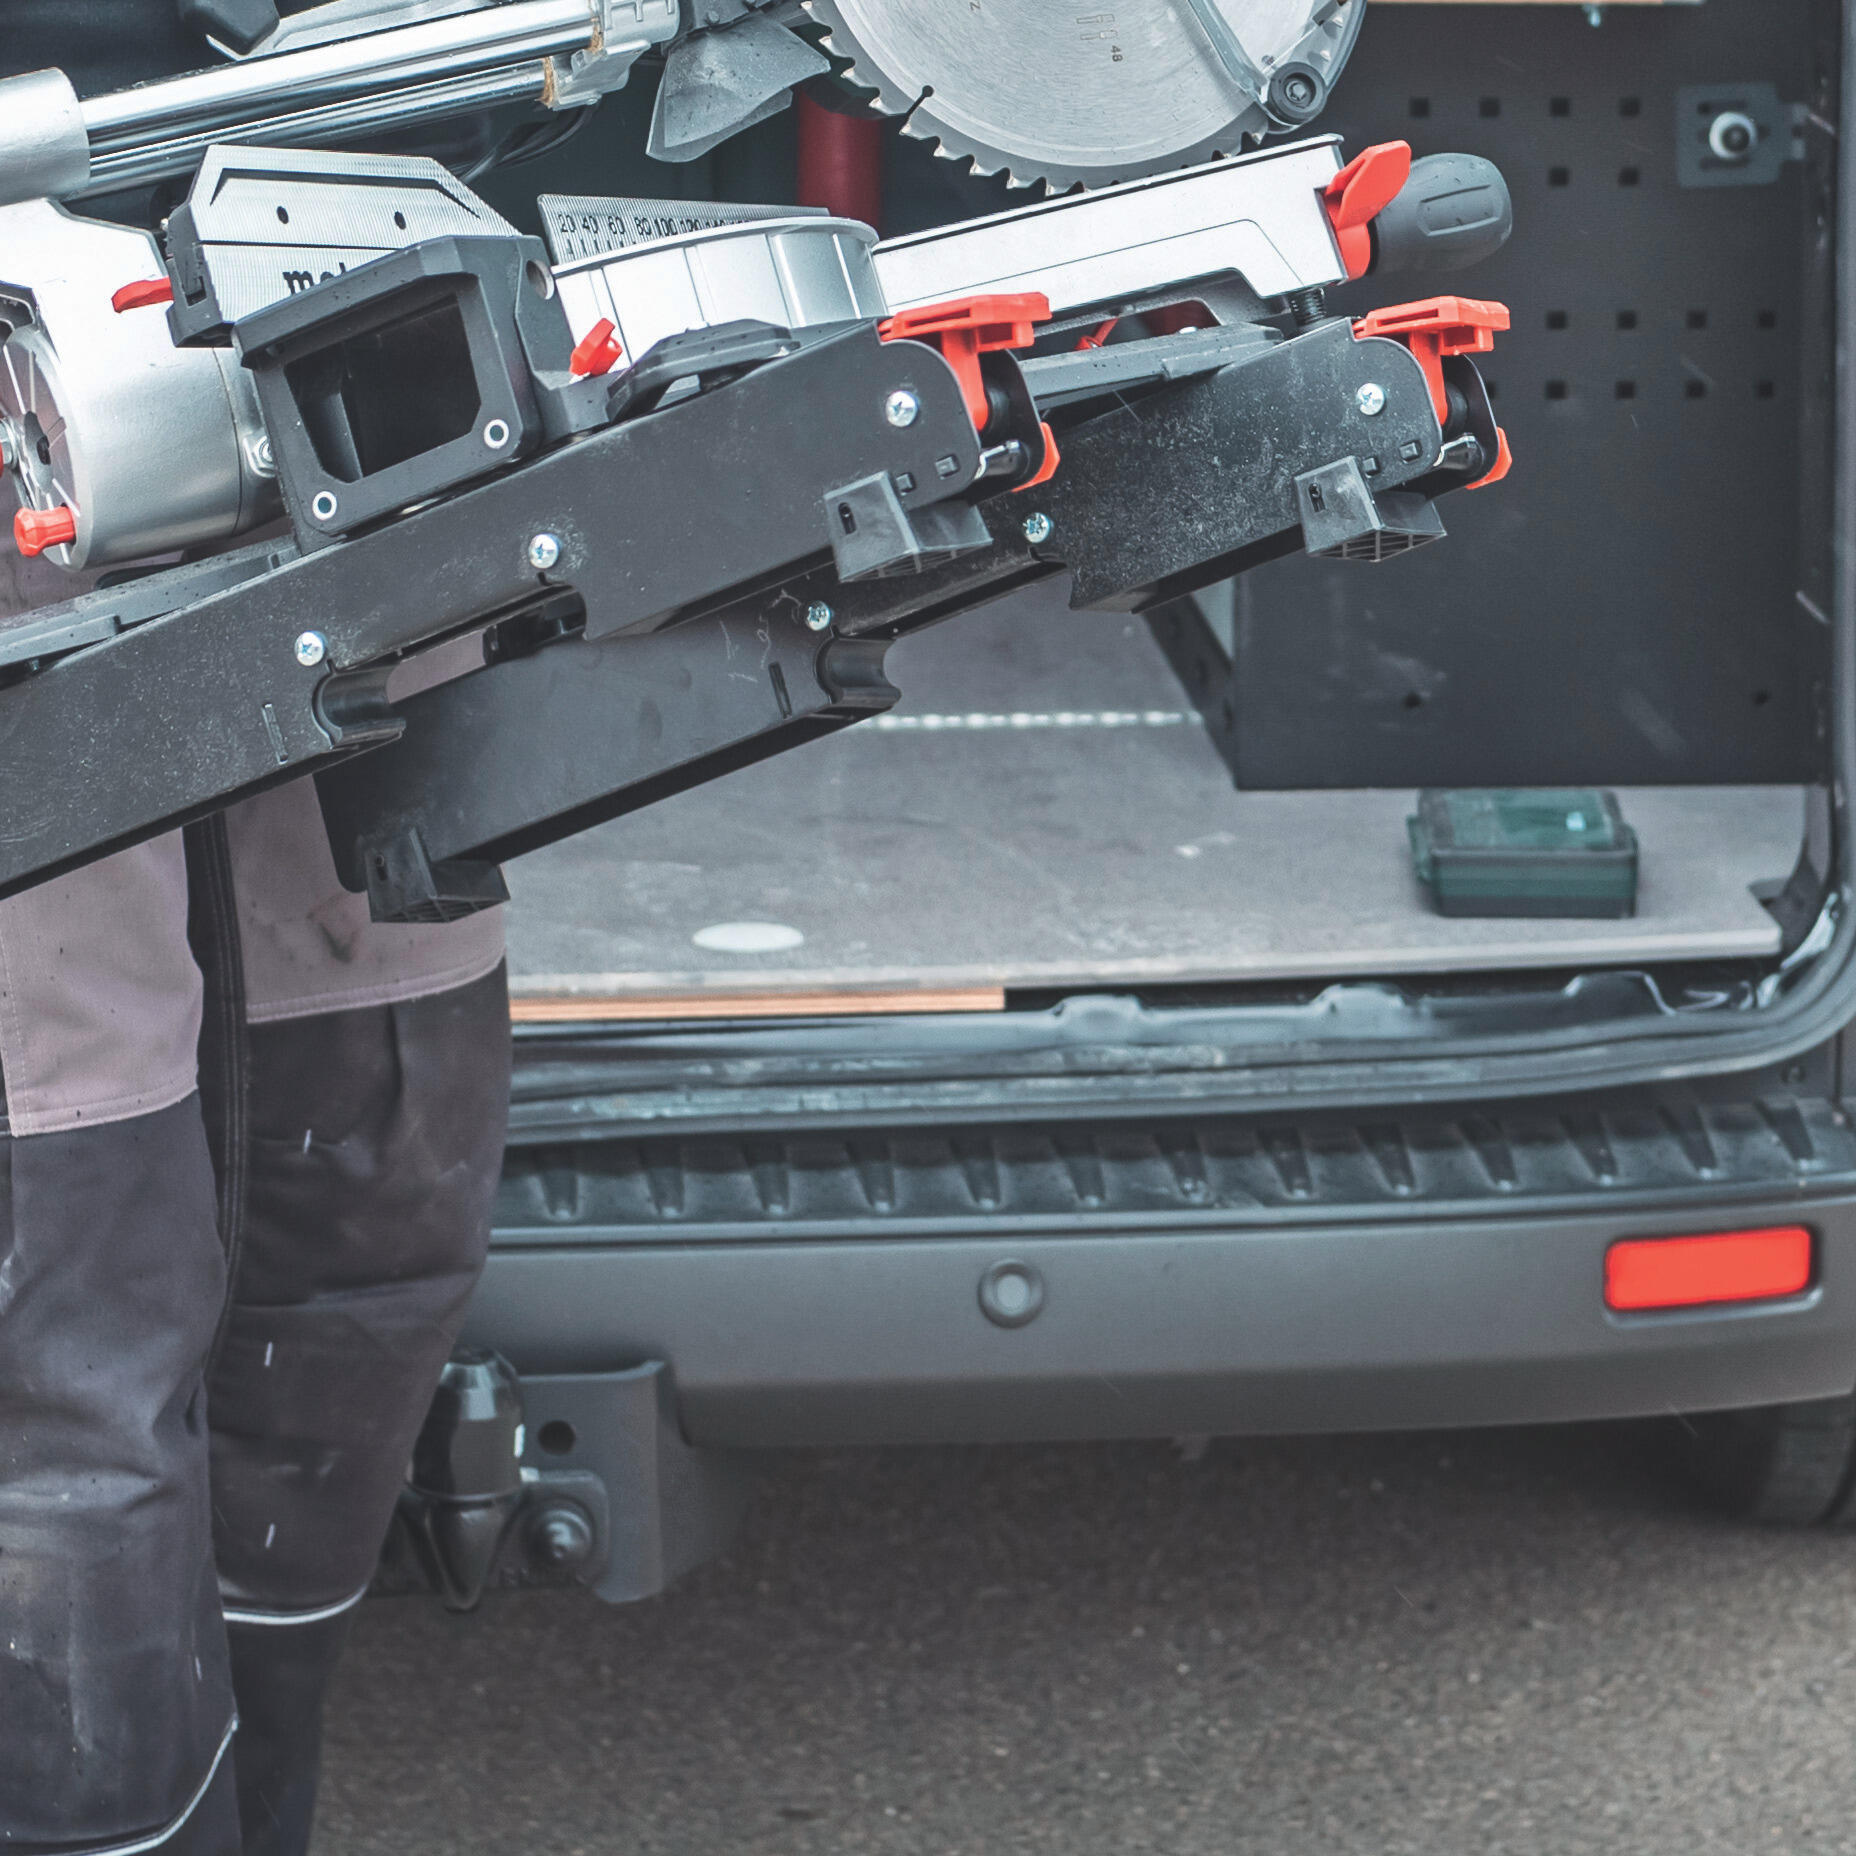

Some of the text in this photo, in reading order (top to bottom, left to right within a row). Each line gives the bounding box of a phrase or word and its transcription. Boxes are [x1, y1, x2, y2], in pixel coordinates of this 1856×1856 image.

[1111, 45, 1123, 62] 48
[558, 213, 576, 232] 20
[582, 215, 599, 233] 40
[608, 215, 624, 234] 60
[634, 217, 652, 235] 80
[654, 218, 677, 236] 100
